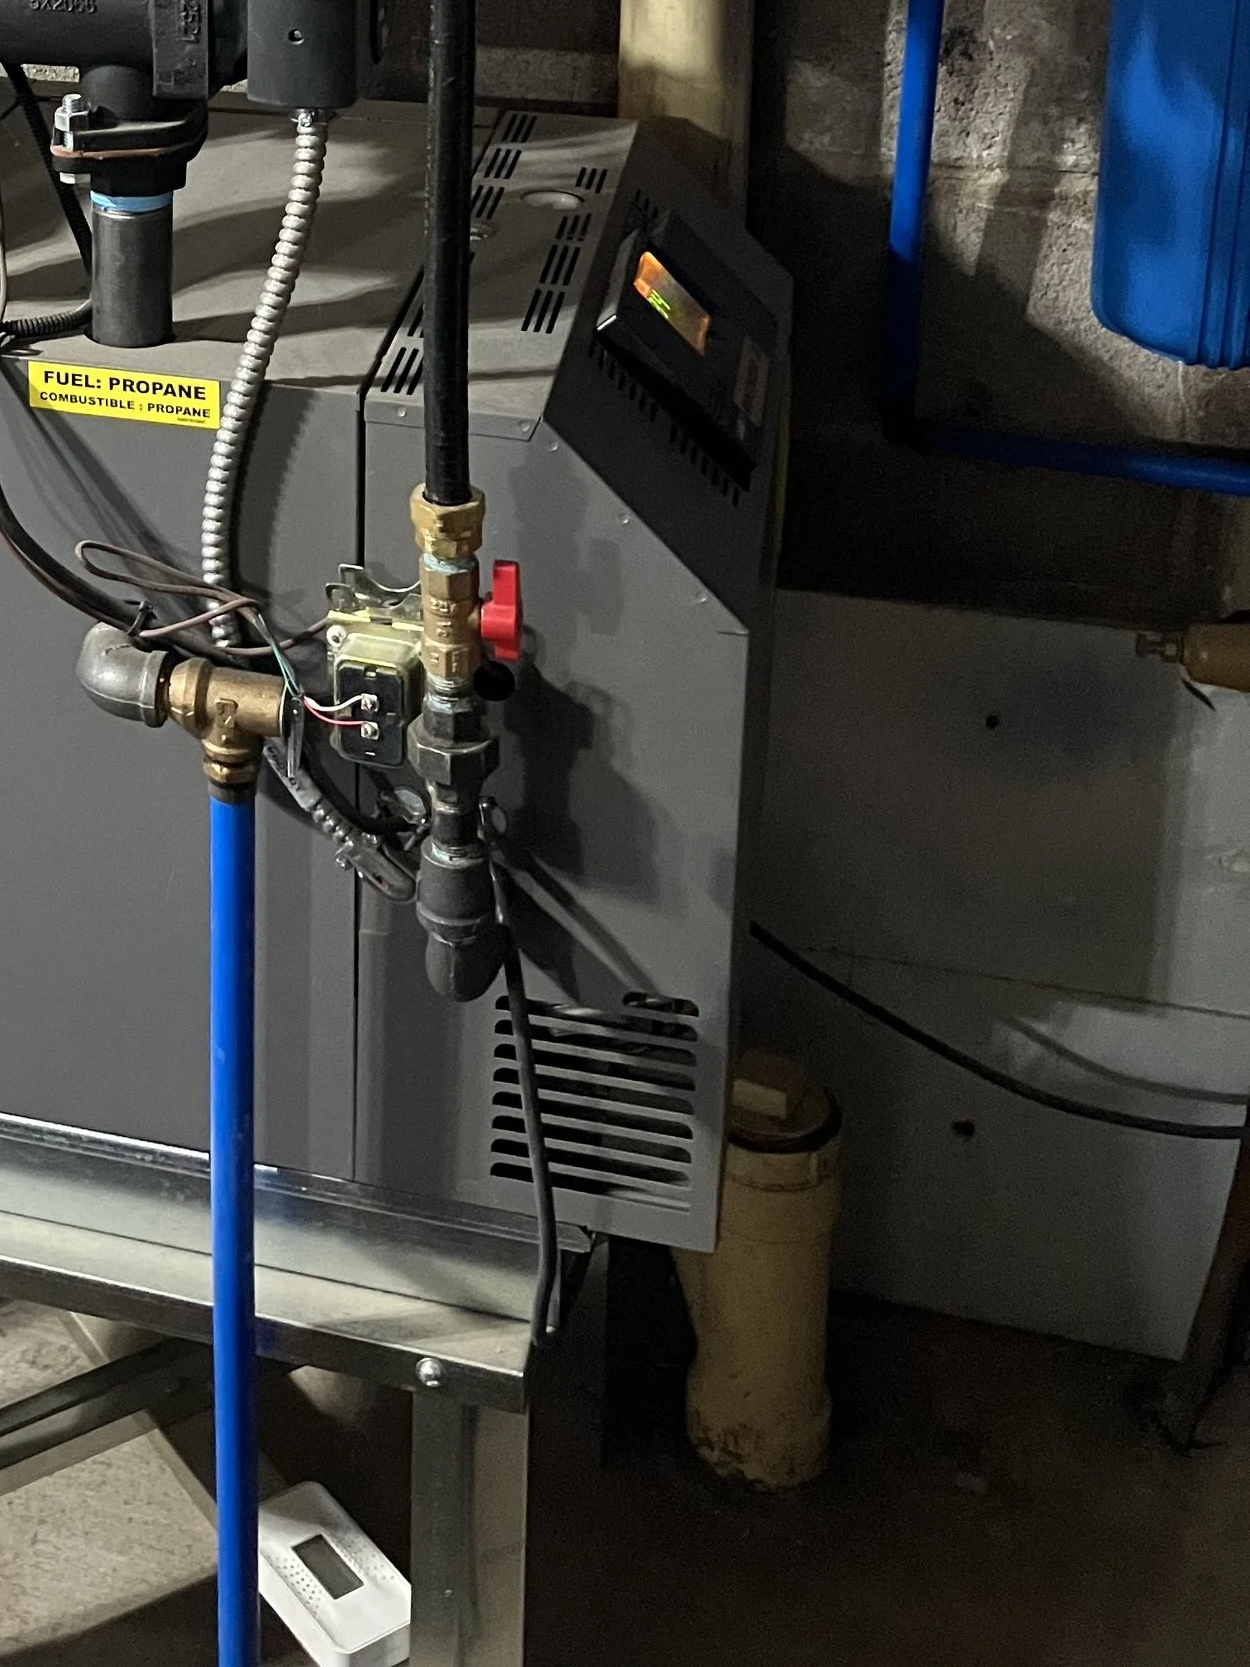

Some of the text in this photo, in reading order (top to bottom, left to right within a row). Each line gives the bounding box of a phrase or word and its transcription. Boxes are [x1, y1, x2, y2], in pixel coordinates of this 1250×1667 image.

[43, 370, 207, 401] FUEL: PROPANE
[39, 391, 135, 410] COMBUSTIBLE
[147, 403, 211, 419] PROPANE
